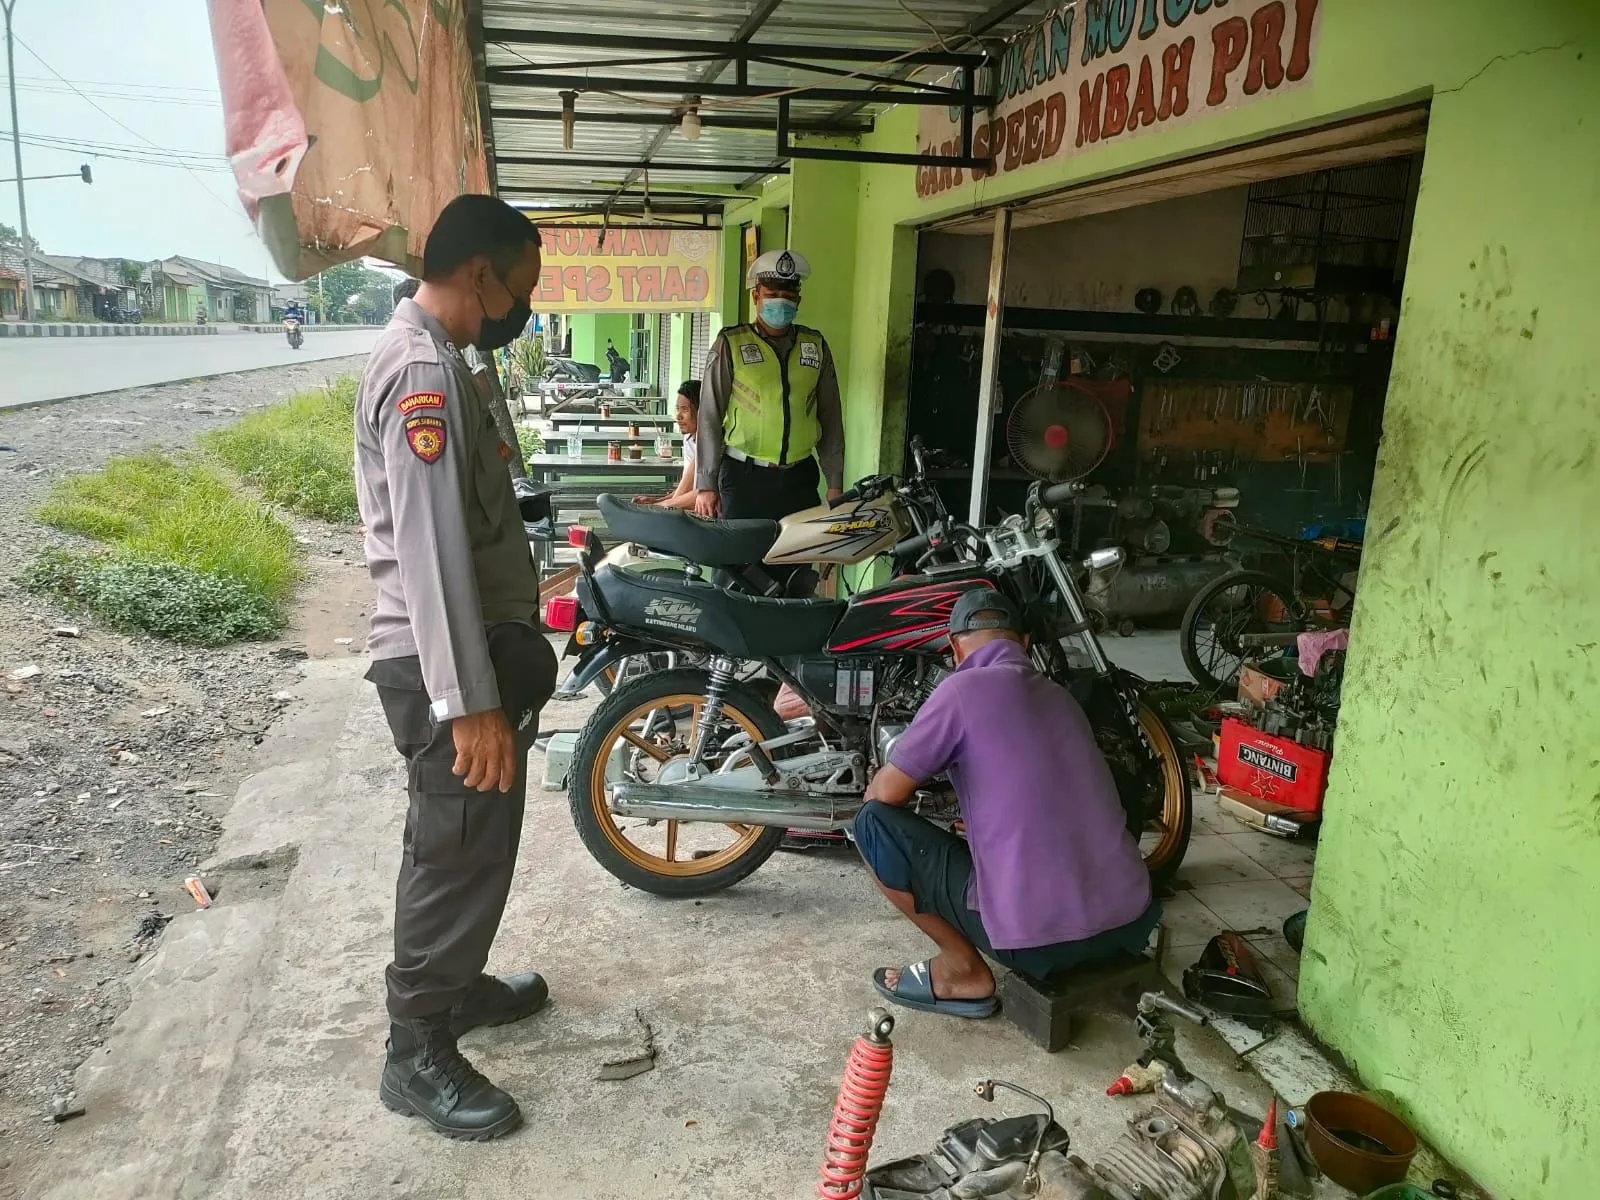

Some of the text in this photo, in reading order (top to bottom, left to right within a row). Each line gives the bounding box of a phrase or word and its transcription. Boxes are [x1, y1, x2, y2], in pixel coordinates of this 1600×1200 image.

[1081, 0, 1229, 67] MOT
[971, 93, 1066, 182] SPEED
[1075, 35, 1195, 149] MBAH
[1206, 0, 1320, 107] PRI
[400, 395, 440, 411] BAHARKAM
[1243, 748, 1292, 778] BINTANG
